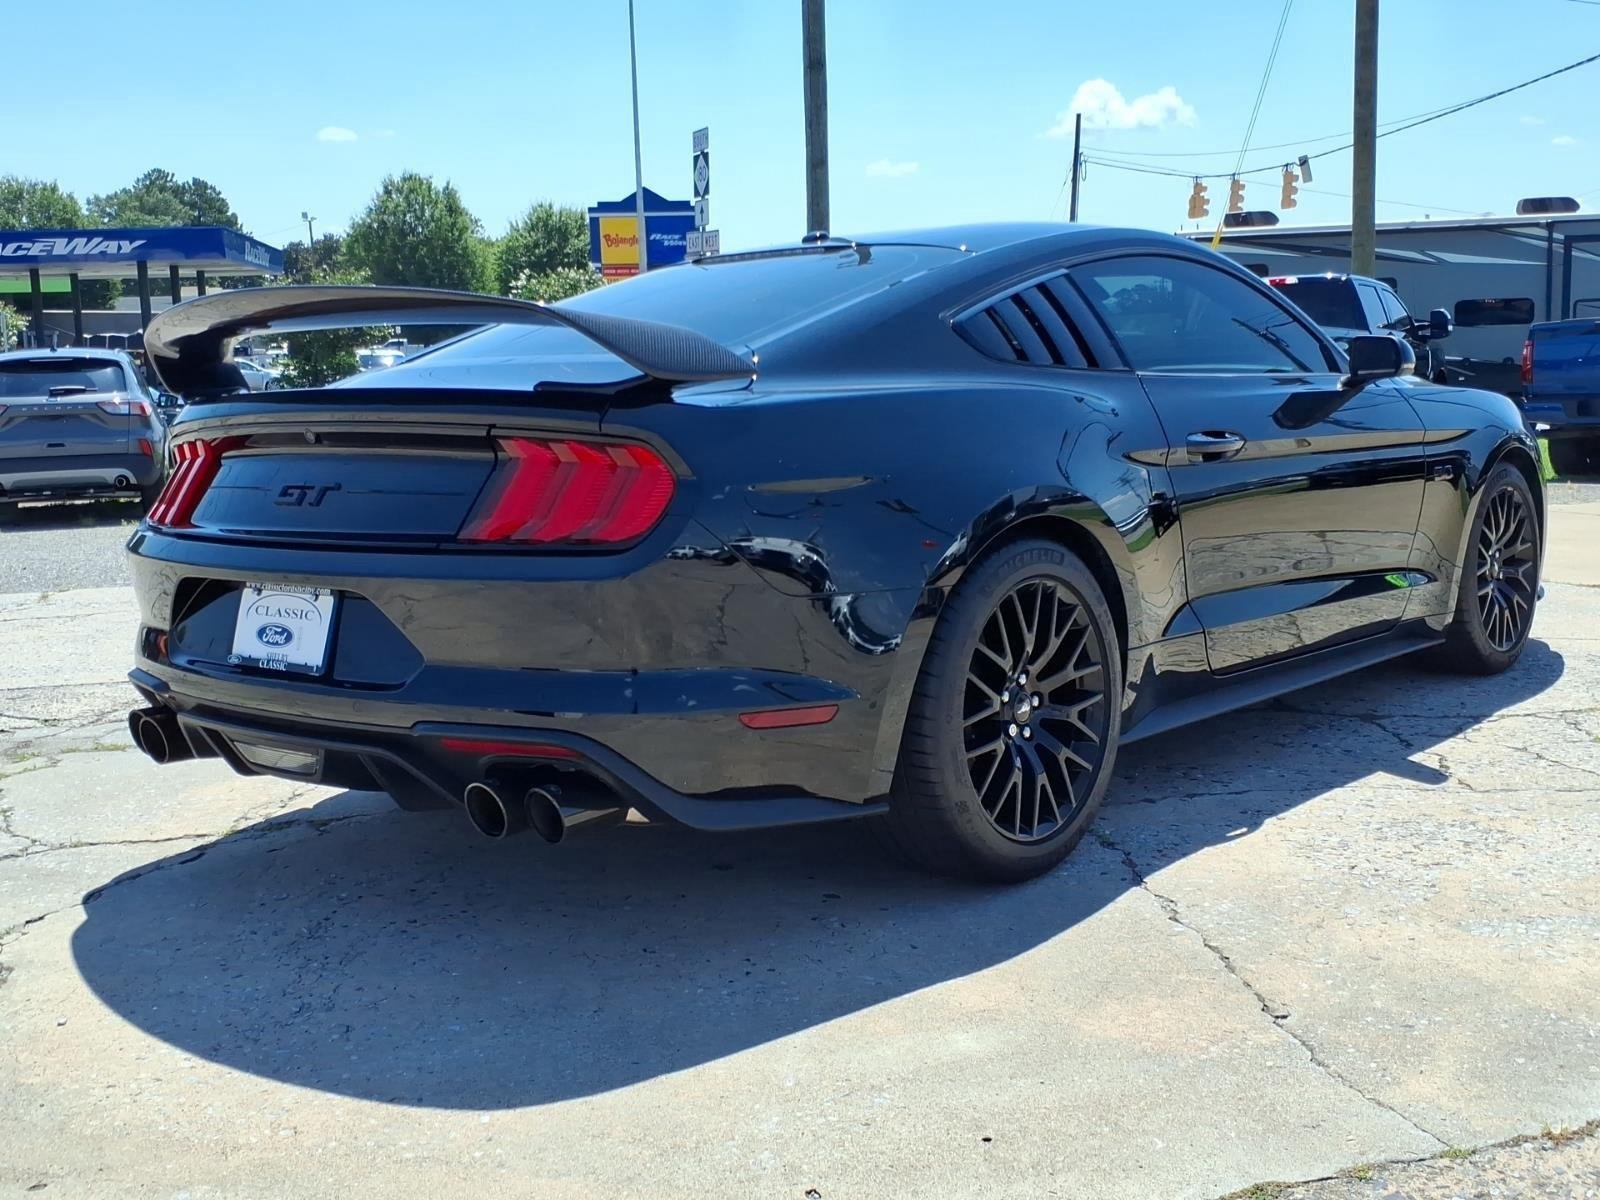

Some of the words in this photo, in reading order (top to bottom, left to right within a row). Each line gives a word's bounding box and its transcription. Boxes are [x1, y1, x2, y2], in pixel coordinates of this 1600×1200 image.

[0, 237, 148, 256] CEWAY
[688, 235, 700, 249] EAST
[705, 234, 718, 248] WEST
[273, 482, 342, 507] GT
[255, 605, 315, 621] CLASSIC
[262, 626, 288, 644] Ford
[259, 658, 288, 671] CLASSIC
